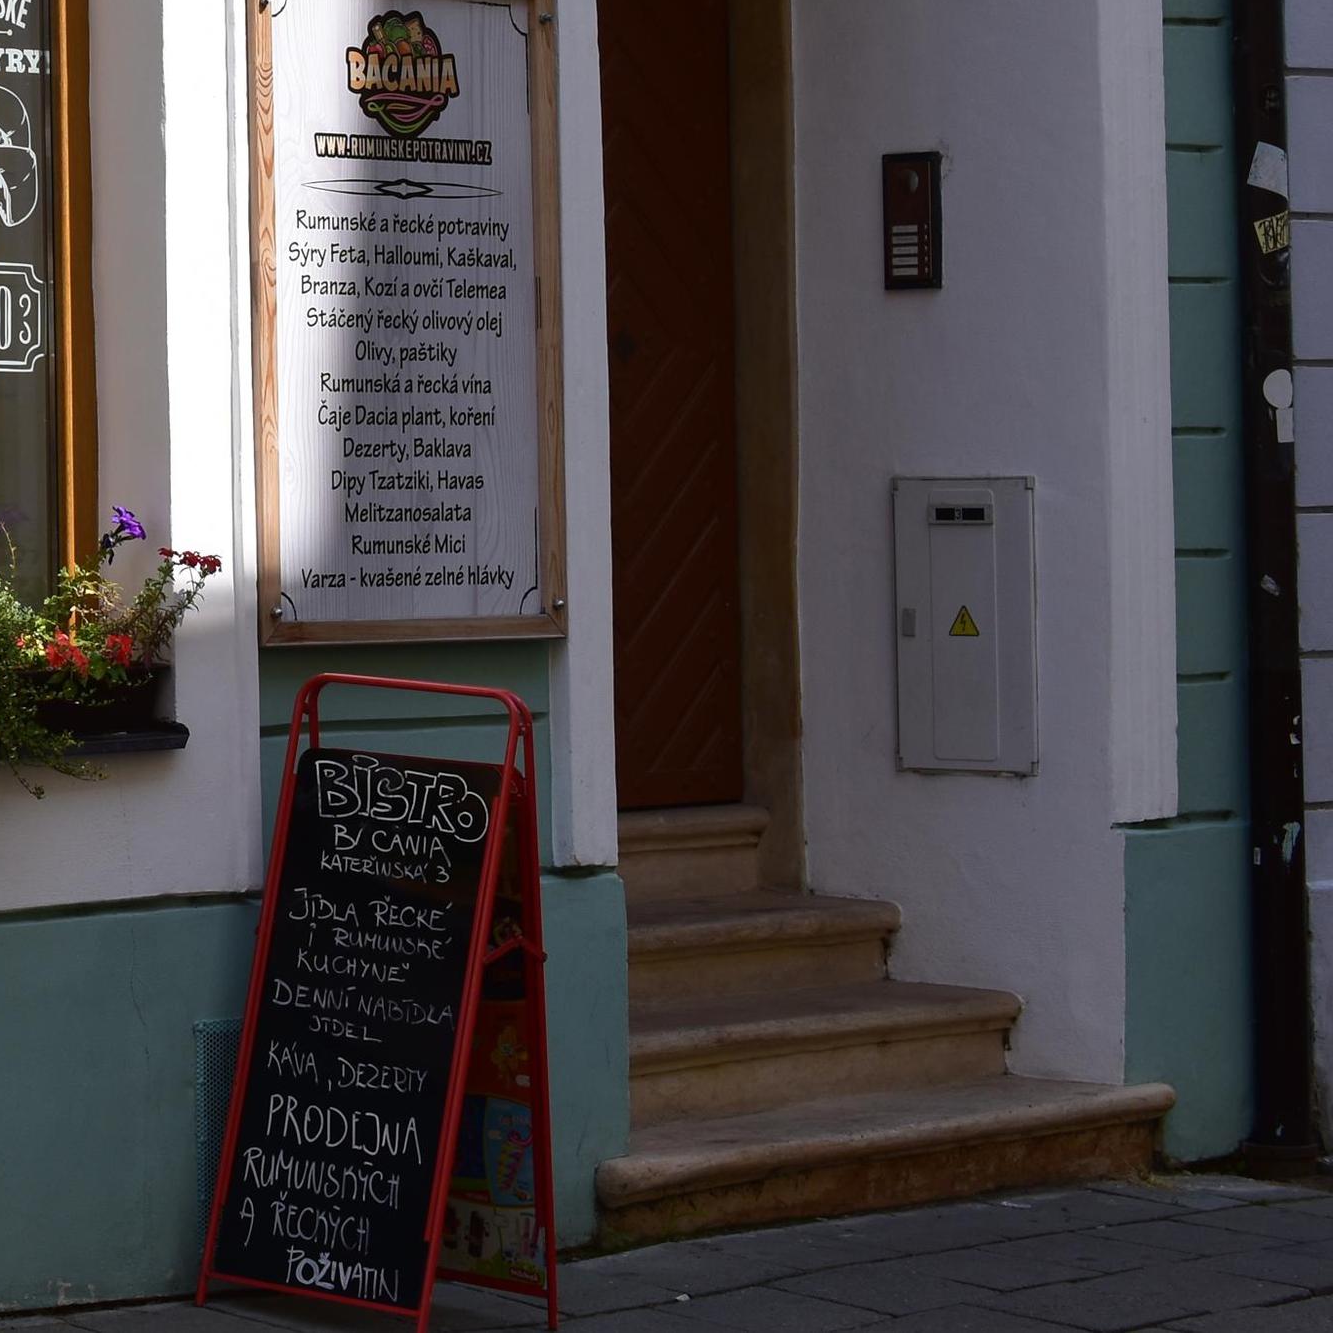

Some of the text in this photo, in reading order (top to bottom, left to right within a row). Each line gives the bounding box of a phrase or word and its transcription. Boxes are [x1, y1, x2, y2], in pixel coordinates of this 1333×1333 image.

[347, 49, 459, 96] BACANIA
[315, 134, 491, 164] WWW.RUMUNSKEPOTRAVINY.CZ
[296, 209, 509, 241] Rumunské a řecké potraviny
[289, 242, 516, 270] Sýry Feta, Halloumi, Kaškaval,
[301, 275, 506, 300] Branza, Kozí a ovčí Telemea
[307, 308, 502, 337] Stáčený řecký olivový olej
[355, 341, 457, 368] Olivy, paštiky
[321, 373, 491, 395] Rumunská a řecká vína
[318, 401, 495, 433] Čaje Dacia plant, koření
[343, 438, 471, 462] Dezerty, Baklava
[332, 470, 483, 498] Dipy Tzatziki, Havas
[345, 502, 471, 523] Melitzanosalata
[352, 534, 465, 555] Rumunské Mici
[302, 565, 514, 590] Varza kvašené zelné hlávky
[316, 755, 488, 842] BISTRO
[321, 851, 449, 883] KATEŘINSKÁ 3
[369, 896, 453, 931] ŘECKÉ
[273, 980, 356, 1008] DENNÍ
[337, 1057, 428, 1093] DEZERTY
[267, 1094, 422, 1164] PRODEJNA
